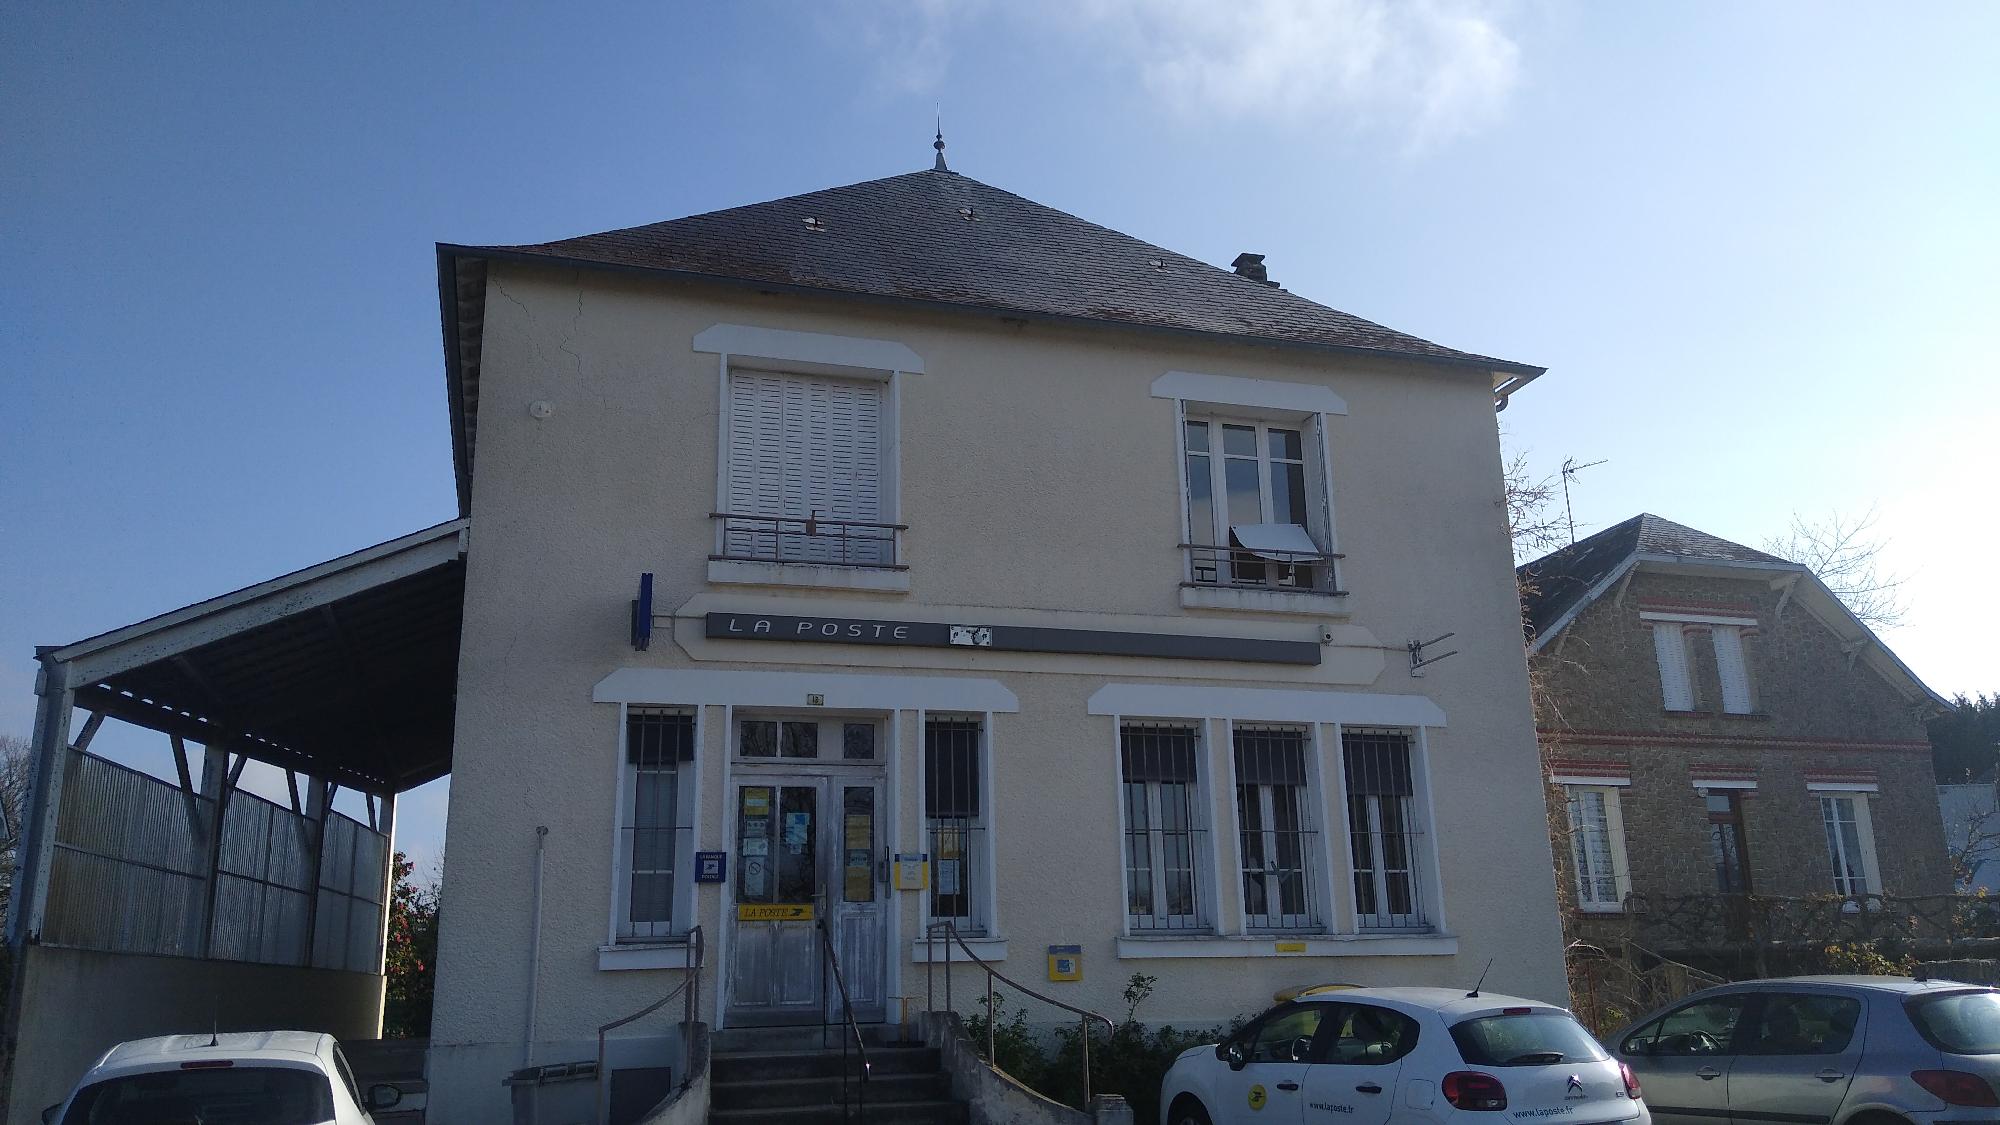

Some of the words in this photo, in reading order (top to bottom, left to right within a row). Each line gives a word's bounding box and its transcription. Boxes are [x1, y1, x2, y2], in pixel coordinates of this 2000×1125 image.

[728, 618, 771, 633] LA
[796, 622, 910, 639] POSTE
[743, 908, 756, 917] LA
[758, 908, 789, 918] POSTE
[1309, 1101, 1355, 1114] www.laposte.fr
[1513, 1105, 1574, 1119] www.laposte.fr
